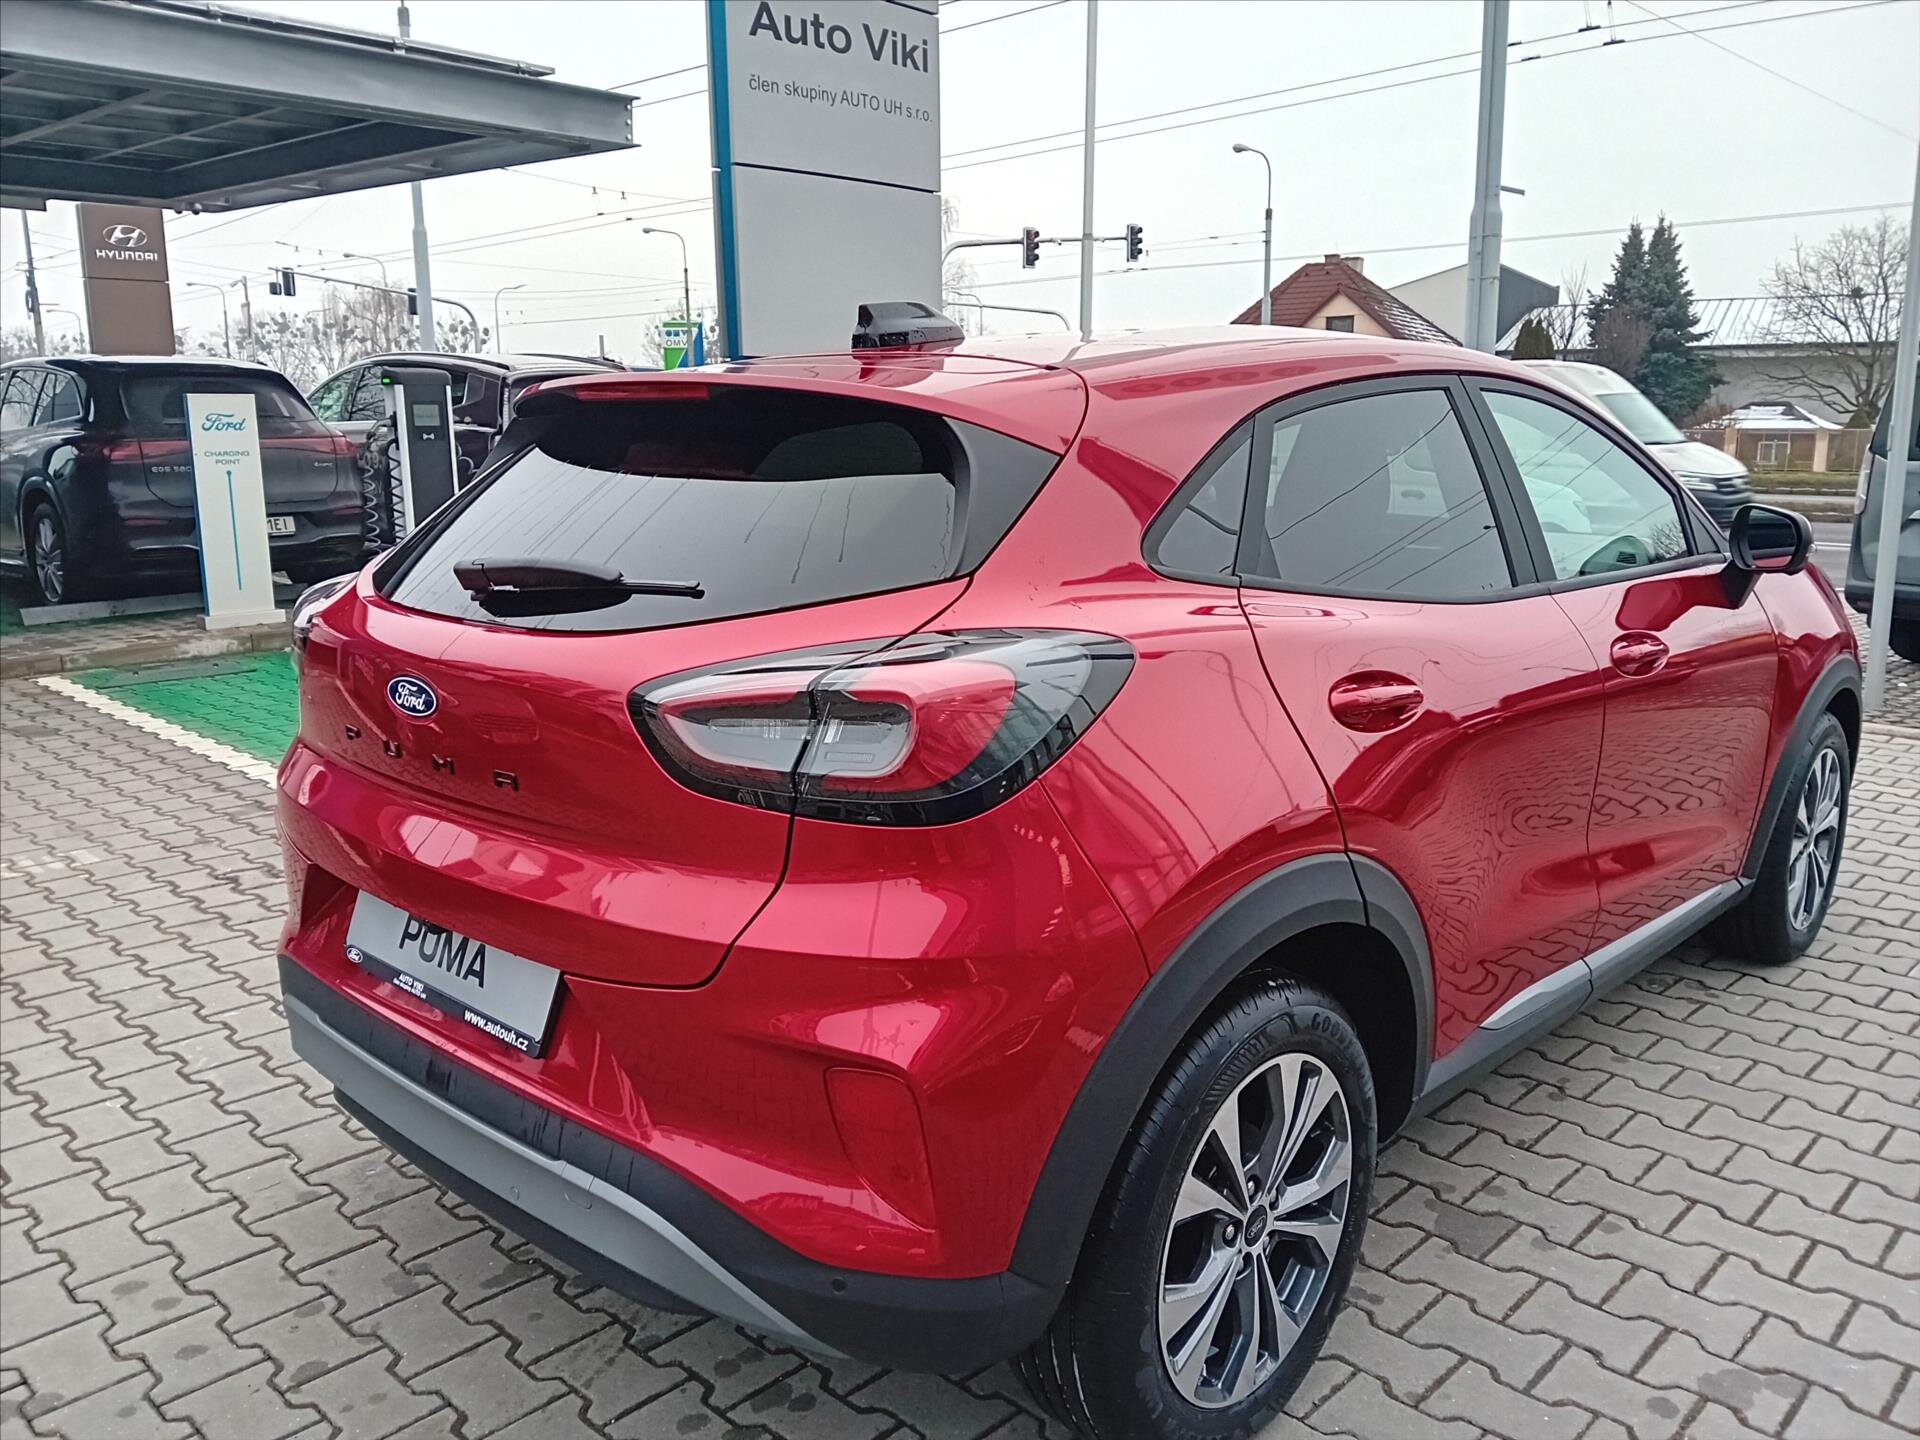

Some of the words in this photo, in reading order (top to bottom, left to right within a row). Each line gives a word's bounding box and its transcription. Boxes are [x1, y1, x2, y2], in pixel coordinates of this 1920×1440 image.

[749, 1, 852, 54] Auto
[862, 23, 928, 73] Viki
[749, 74, 779, 94] člen
[784, 81, 837, 107] skupiny
[840, 90, 880, 111] AUTO
[884, 99, 902, 116] UH
[906, 106, 933, 122] s.r.o.
[95, 249, 158, 261] HYUNDAI
[201, 412, 246, 431] Ford
[395, 681, 426, 711] Ford
[346, 723, 519, 792] PUMA
[398, 913, 486, 989] PUMA
[464, 1009, 529, 1052] www.autouh.cz
